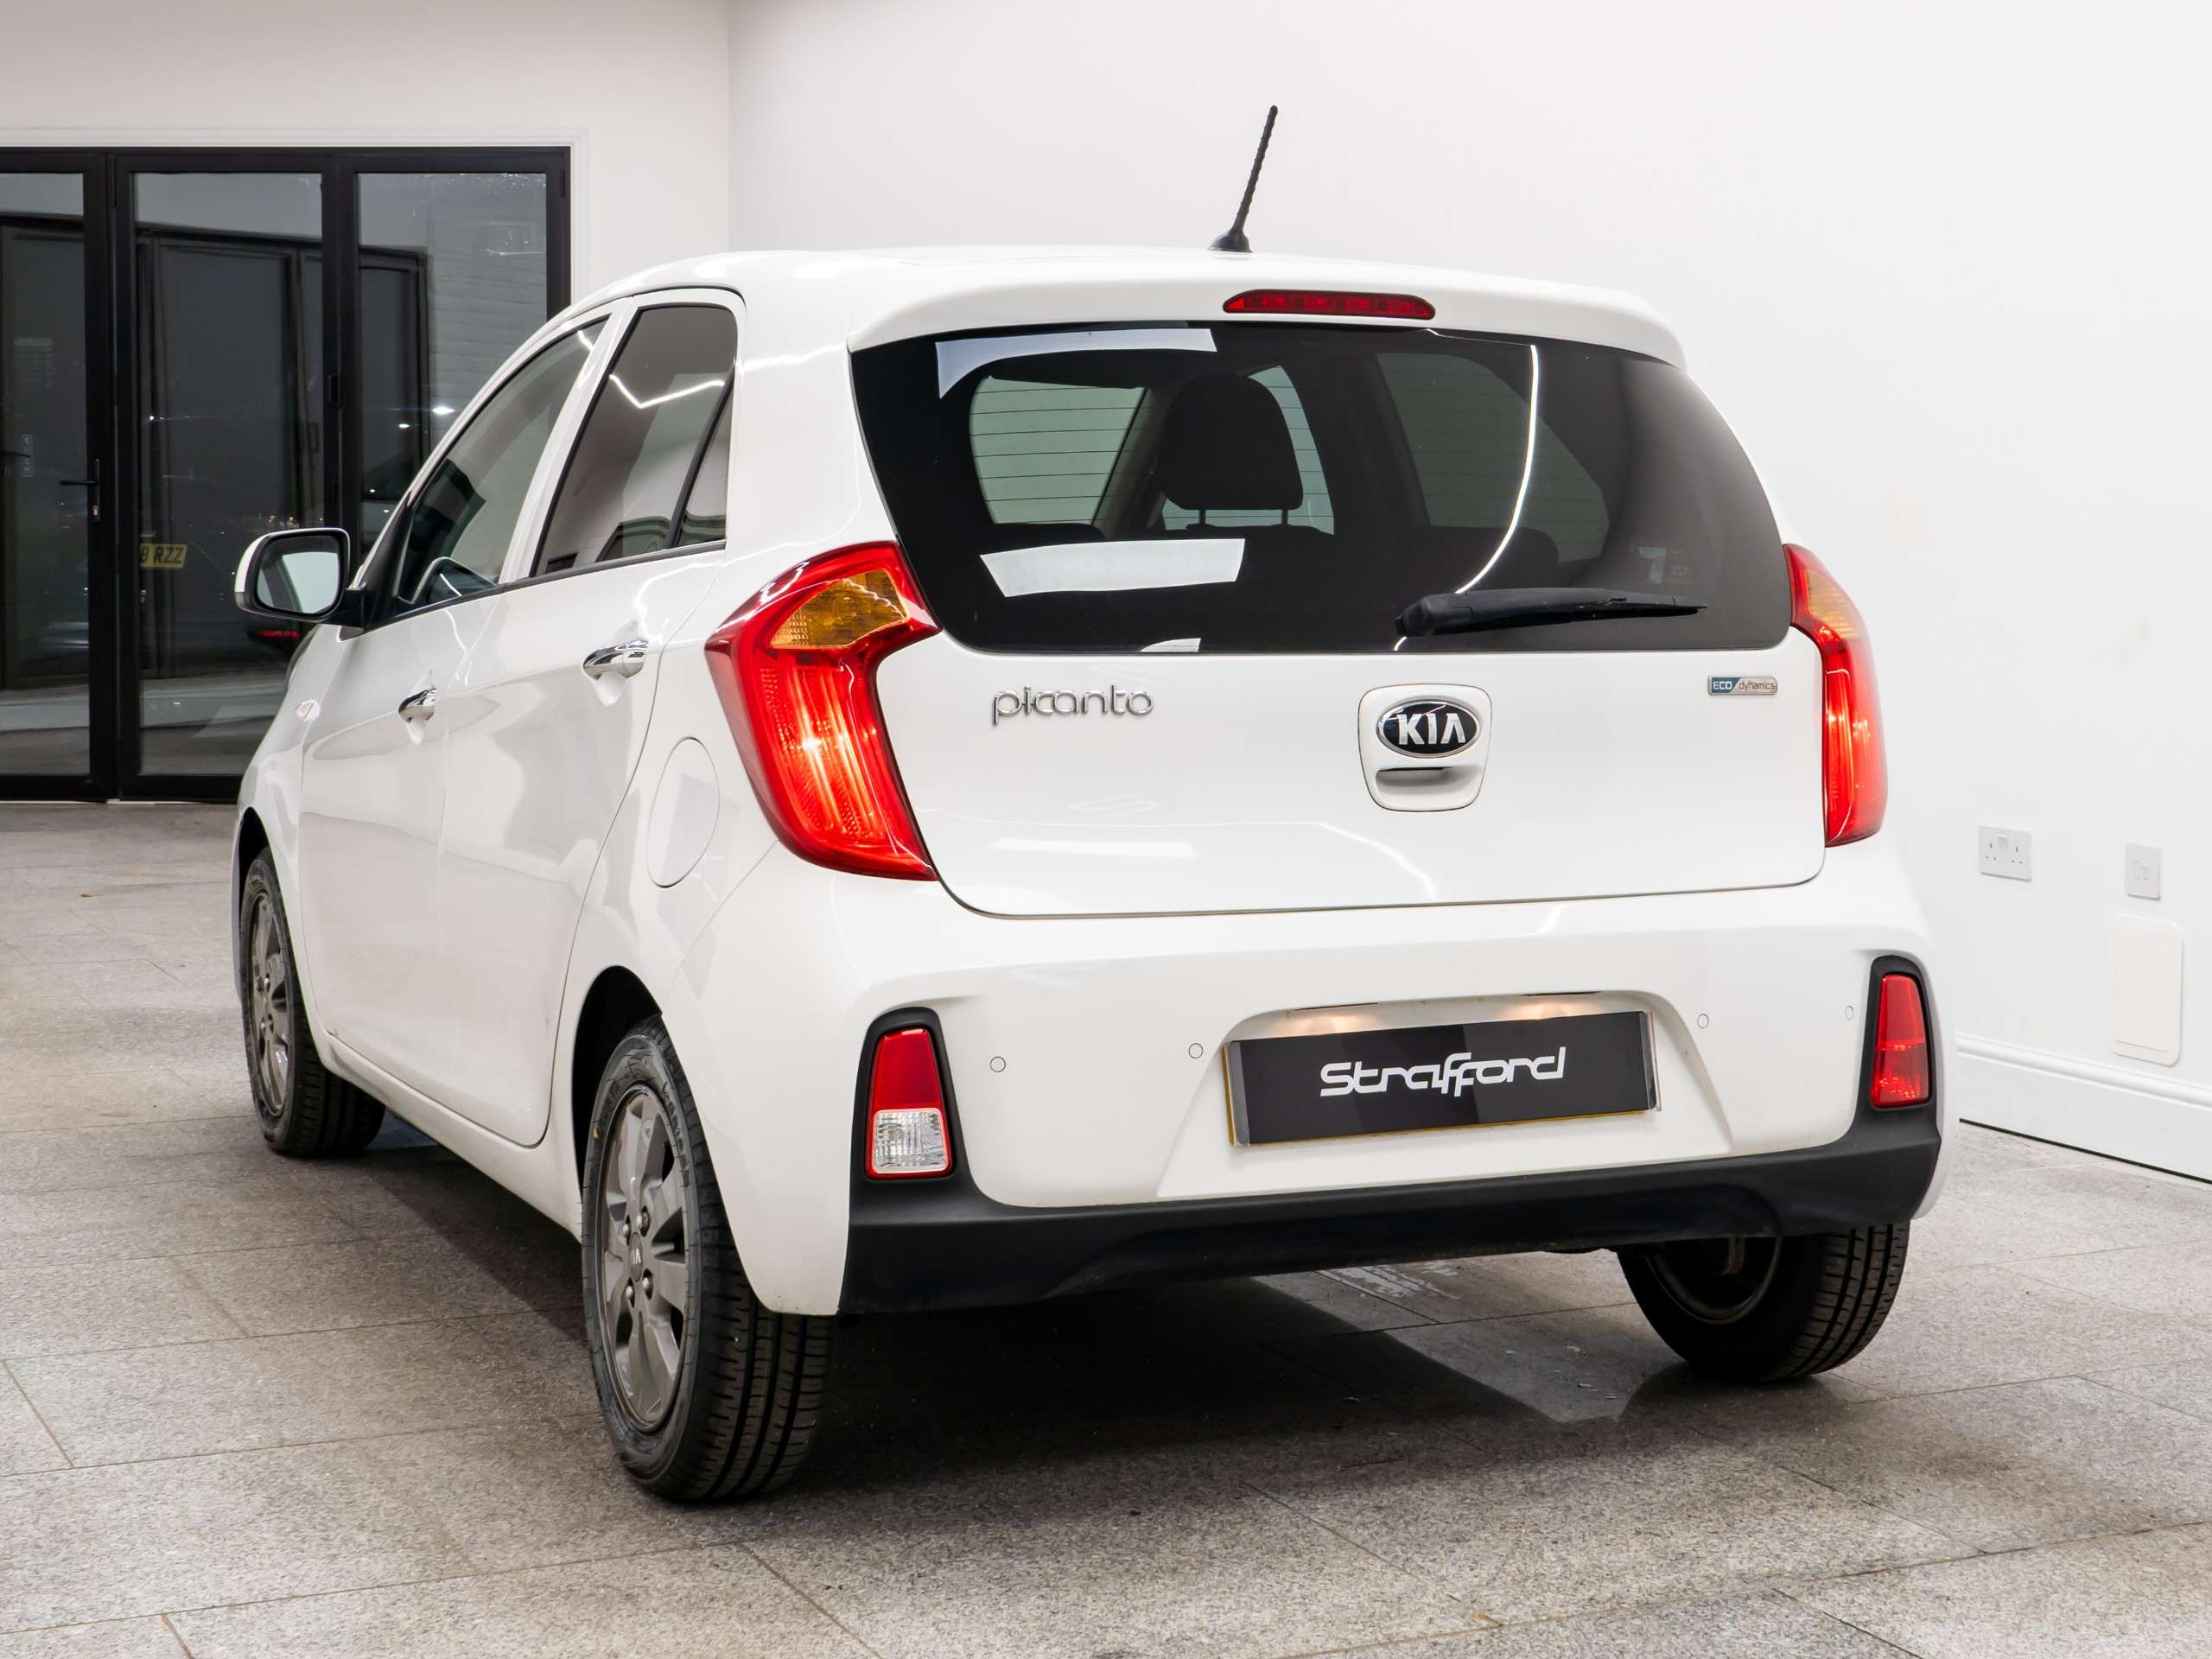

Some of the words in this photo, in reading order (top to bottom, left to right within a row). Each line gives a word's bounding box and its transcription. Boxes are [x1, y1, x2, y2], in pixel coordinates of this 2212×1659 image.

[153, 545, 185, 564] RZZ
[1713, 681, 1732, 690] ECO
[1738, 679, 1775, 692] dynamics
[992, 684, 1154, 726] picanto
[1396, 713, 1466, 745] KIA
[1320, 1046, 1567, 1096] Strafford
